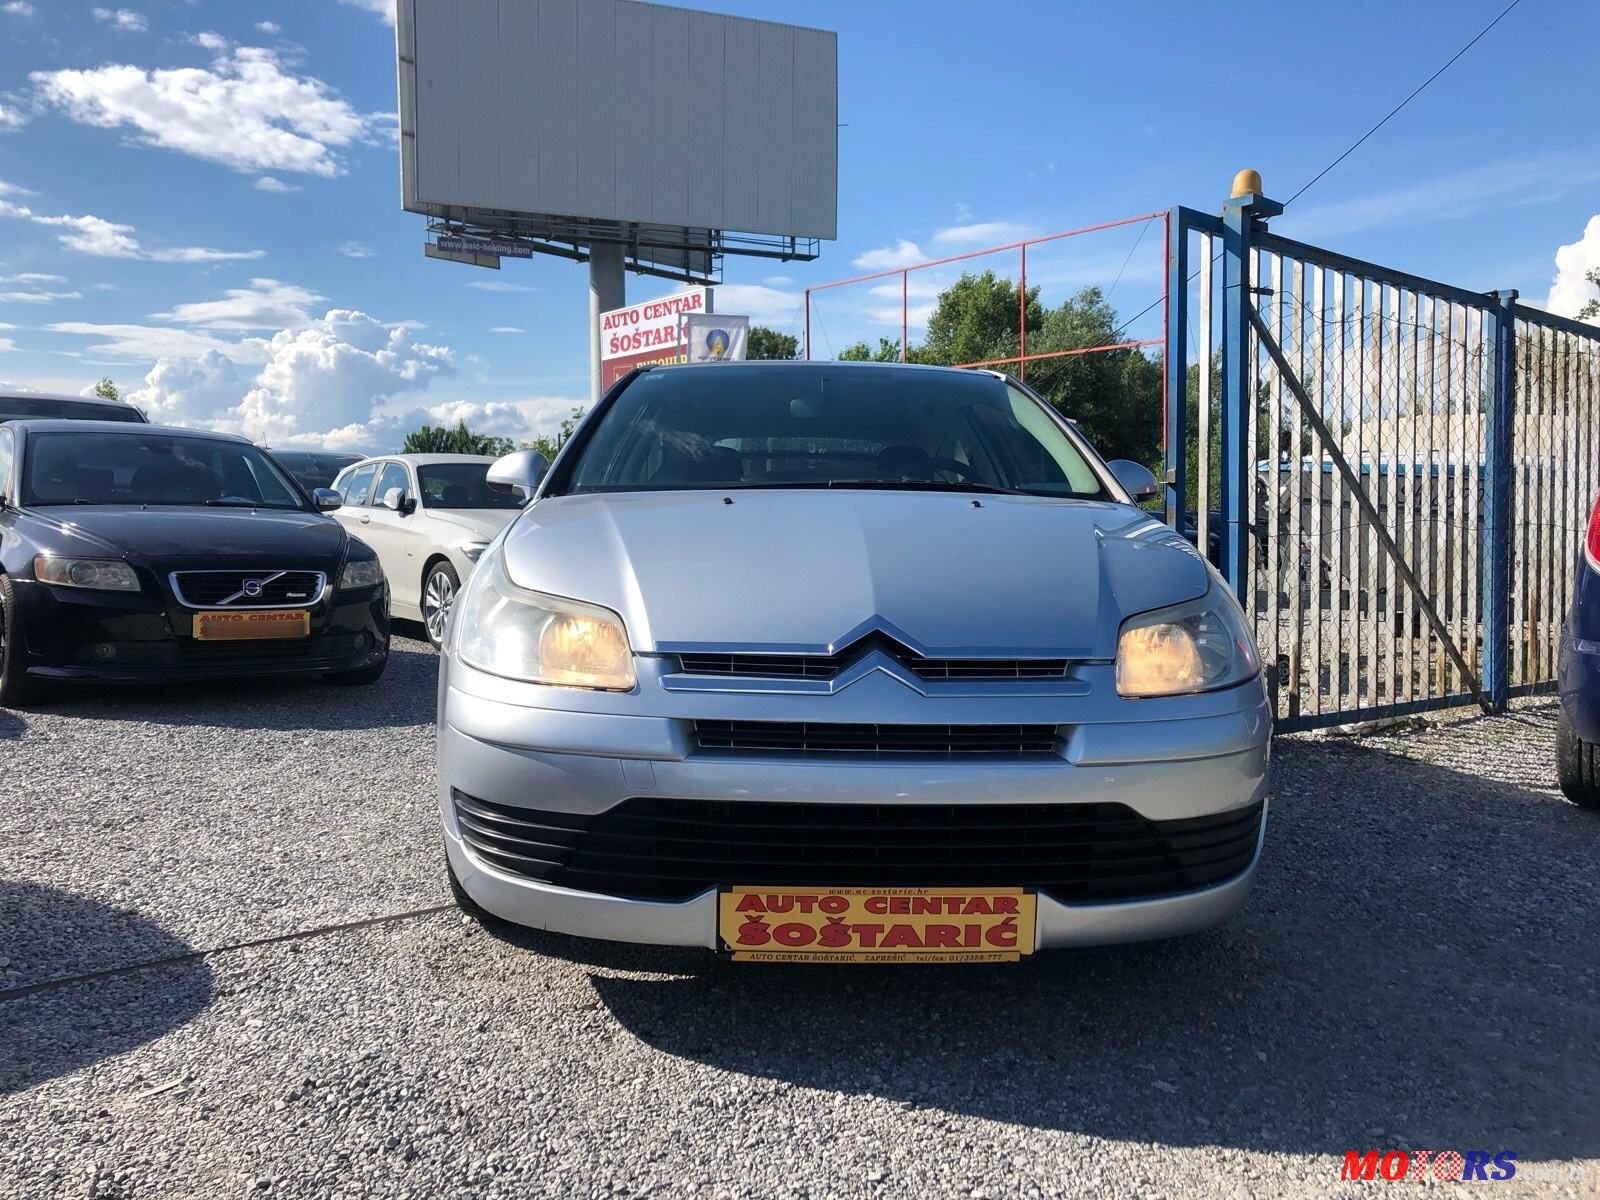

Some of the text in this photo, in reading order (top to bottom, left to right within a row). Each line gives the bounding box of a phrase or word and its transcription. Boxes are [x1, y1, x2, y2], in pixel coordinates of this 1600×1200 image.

[603, 293, 703, 331] AUTO CENTAR
[199, 613, 305, 623] AUTO CENTAR
[735, 894, 1021, 915] AUTO CENTAR
[735, 914, 1019, 948] ŠOŠTARIĆ
[750, 953, 774, 961] AUTO
[775, 953, 810, 961] CENTAR
